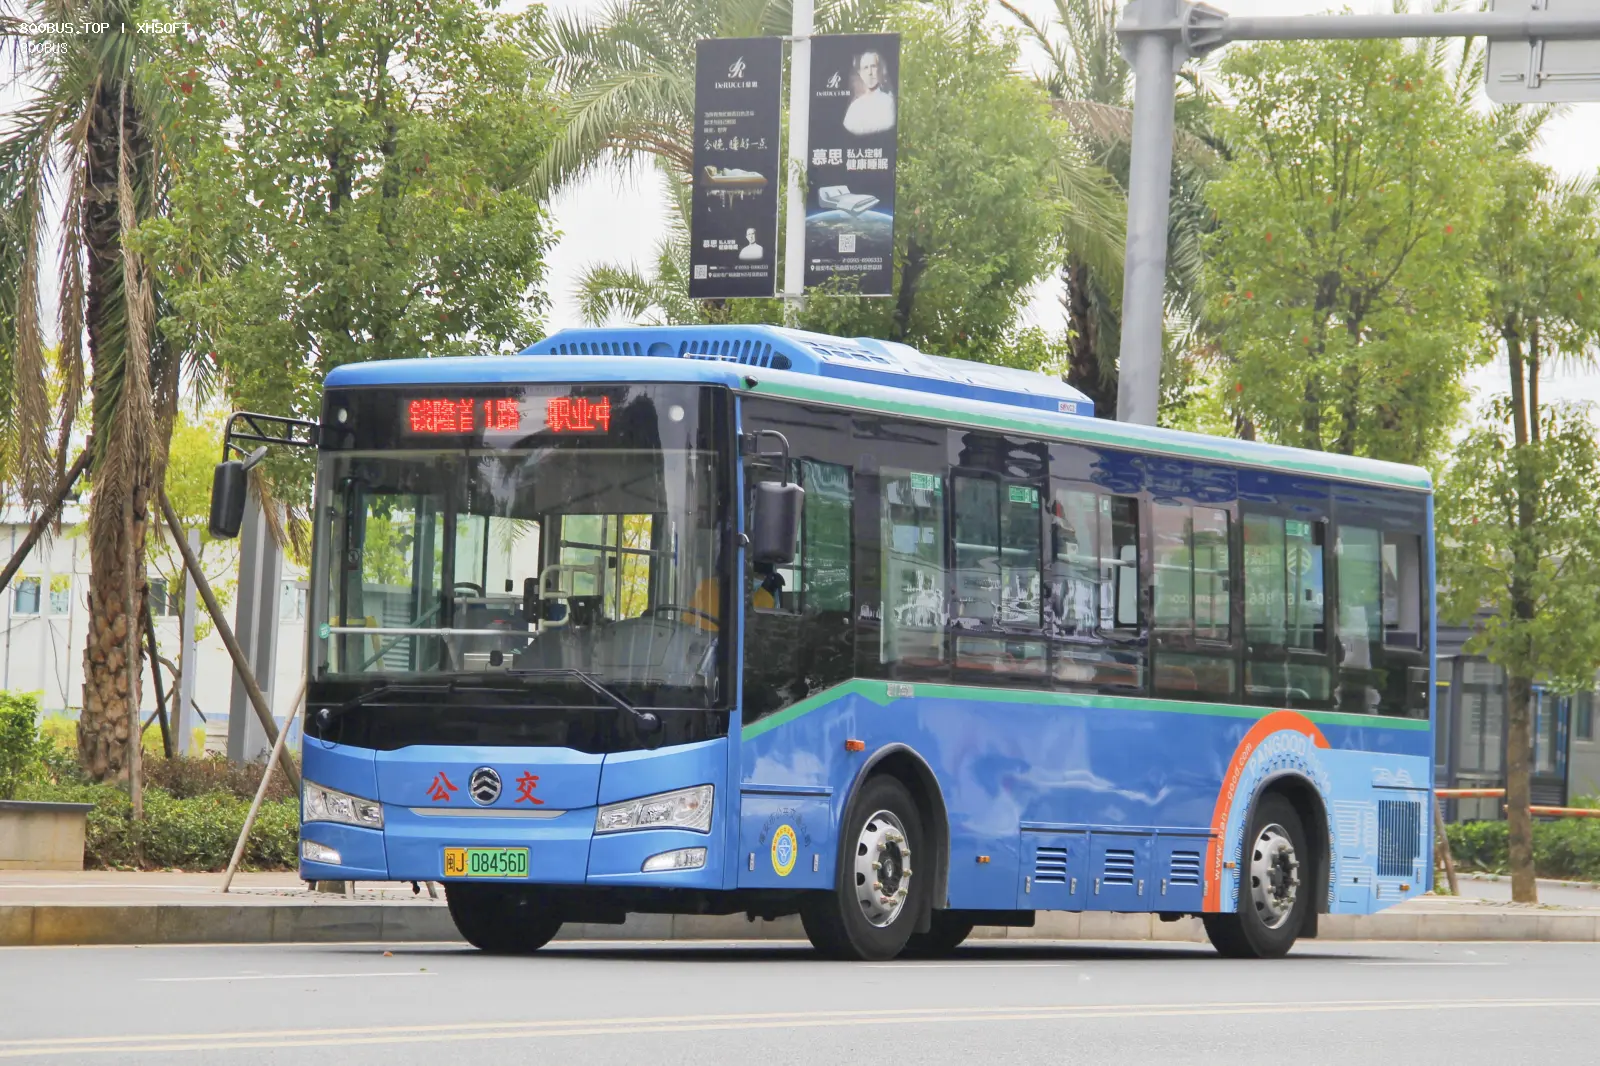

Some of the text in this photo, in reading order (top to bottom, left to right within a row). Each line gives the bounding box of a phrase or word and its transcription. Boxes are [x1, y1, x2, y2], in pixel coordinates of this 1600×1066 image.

[812, 148, 843, 166] 慕思
[426, 771, 545, 805] 公 交
